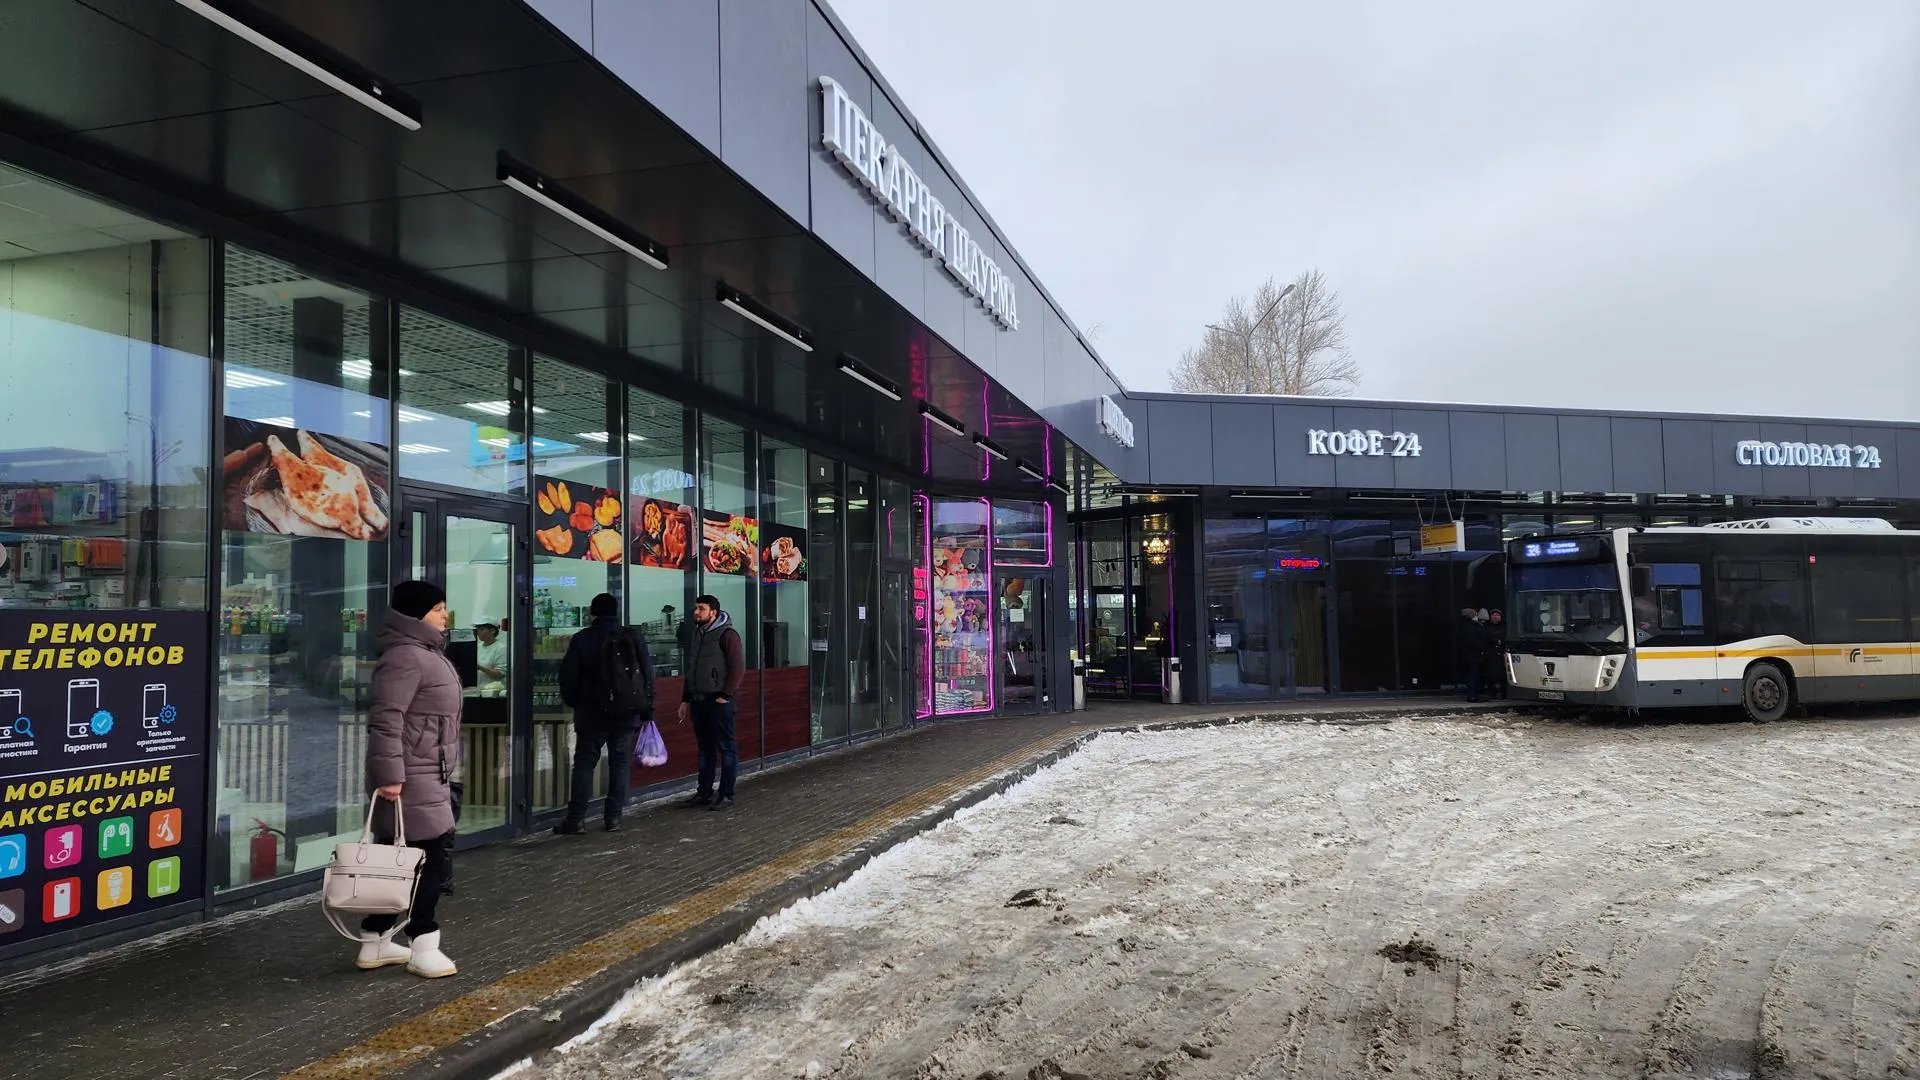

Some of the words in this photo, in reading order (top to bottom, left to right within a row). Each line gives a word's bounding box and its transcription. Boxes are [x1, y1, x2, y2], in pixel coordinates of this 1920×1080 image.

[818, 75, 946, 261] ПЕКАРНЯ
[944, 212, 1019, 331] ШАУРМА
[1307, 428, 1384, 456] КОФЕ
[1391, 431, 1422, 457] 24
[1736, 440, 1852, 467] СТОЛОВАЯ
[1854, 444, 1882, 468] 24
[28, 623, 157, 644] РЕМОНТ
[0, 646, 184, 671] ТЕЛЕФОНОВ
[148, 730, 172, 738] Только
[0, 749, 39, 758] гностика
[63, 742, 108, 754] Гарантия
[5, 765, 172, 803] МОБИЛЬНЫЕ
[0, 787, 175, 829] АКСЕССУАРЫ
